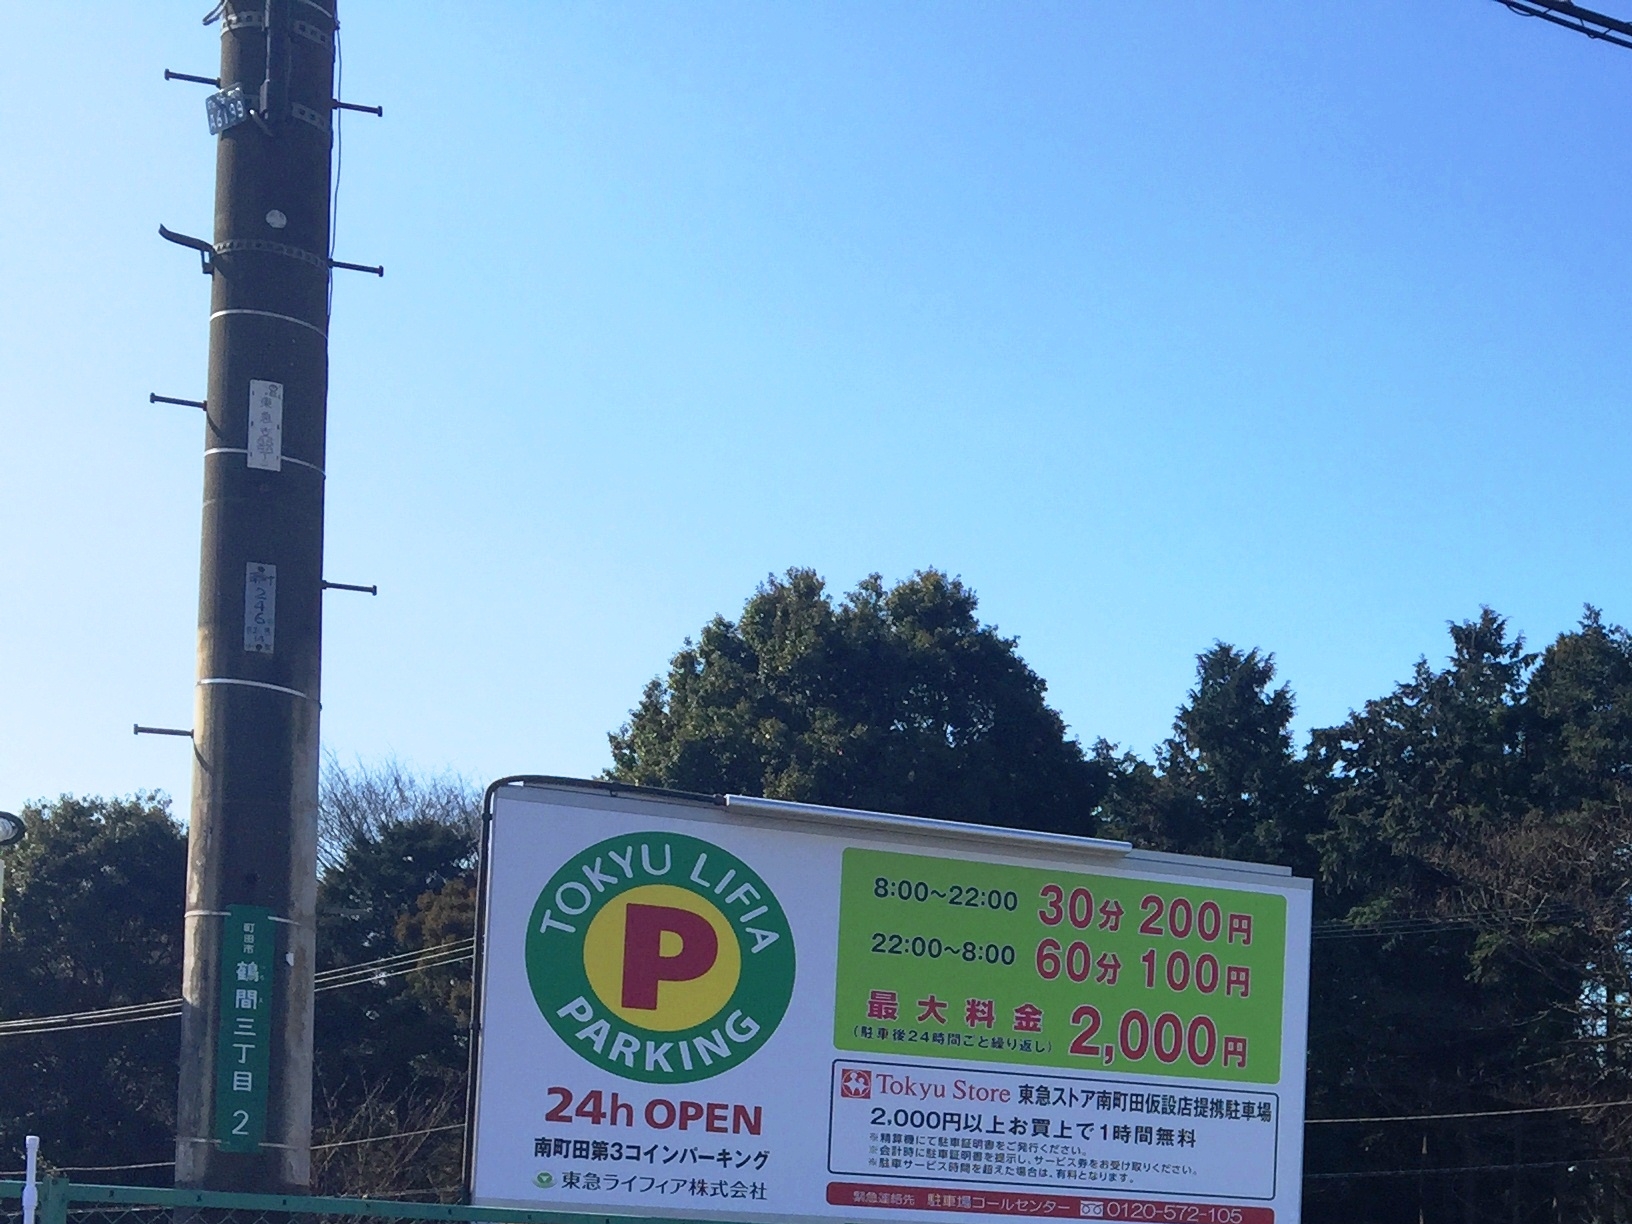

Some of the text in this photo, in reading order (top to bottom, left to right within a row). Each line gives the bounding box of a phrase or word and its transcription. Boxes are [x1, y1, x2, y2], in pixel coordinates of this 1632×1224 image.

[539, 843, 780, 954] TOKYU LIFIA
[1037, 883, 1125, 932] 30分
[1139, 894, 1254, 947] 200円
[621, 902, 719, 1011] P
[1035, 938, 1122, 986] 60分
[1141, 948, 1251, 998] 100円
[232, 960, 260, 1092] 鶴間三丁目
[556, 995, 761, 1073] PARKING
[1069, 1004, 1248, 1069] 2,000円
[544, 1086, 763, 1136] 24h OPEN
[876, 1073, 1011, 1103] Tokyu Store
[231, 1110, 250, 1135] 2
[533, 1136, 771, 1171] 南町田第3コインパーキング
[561, 1170, 769, 1200] 東急ライフィア株式会社
[927, 1193, 1071, 1213] 駐車場コールセンター
[1107, 1201, 1243, 1224] 0120-572-105
